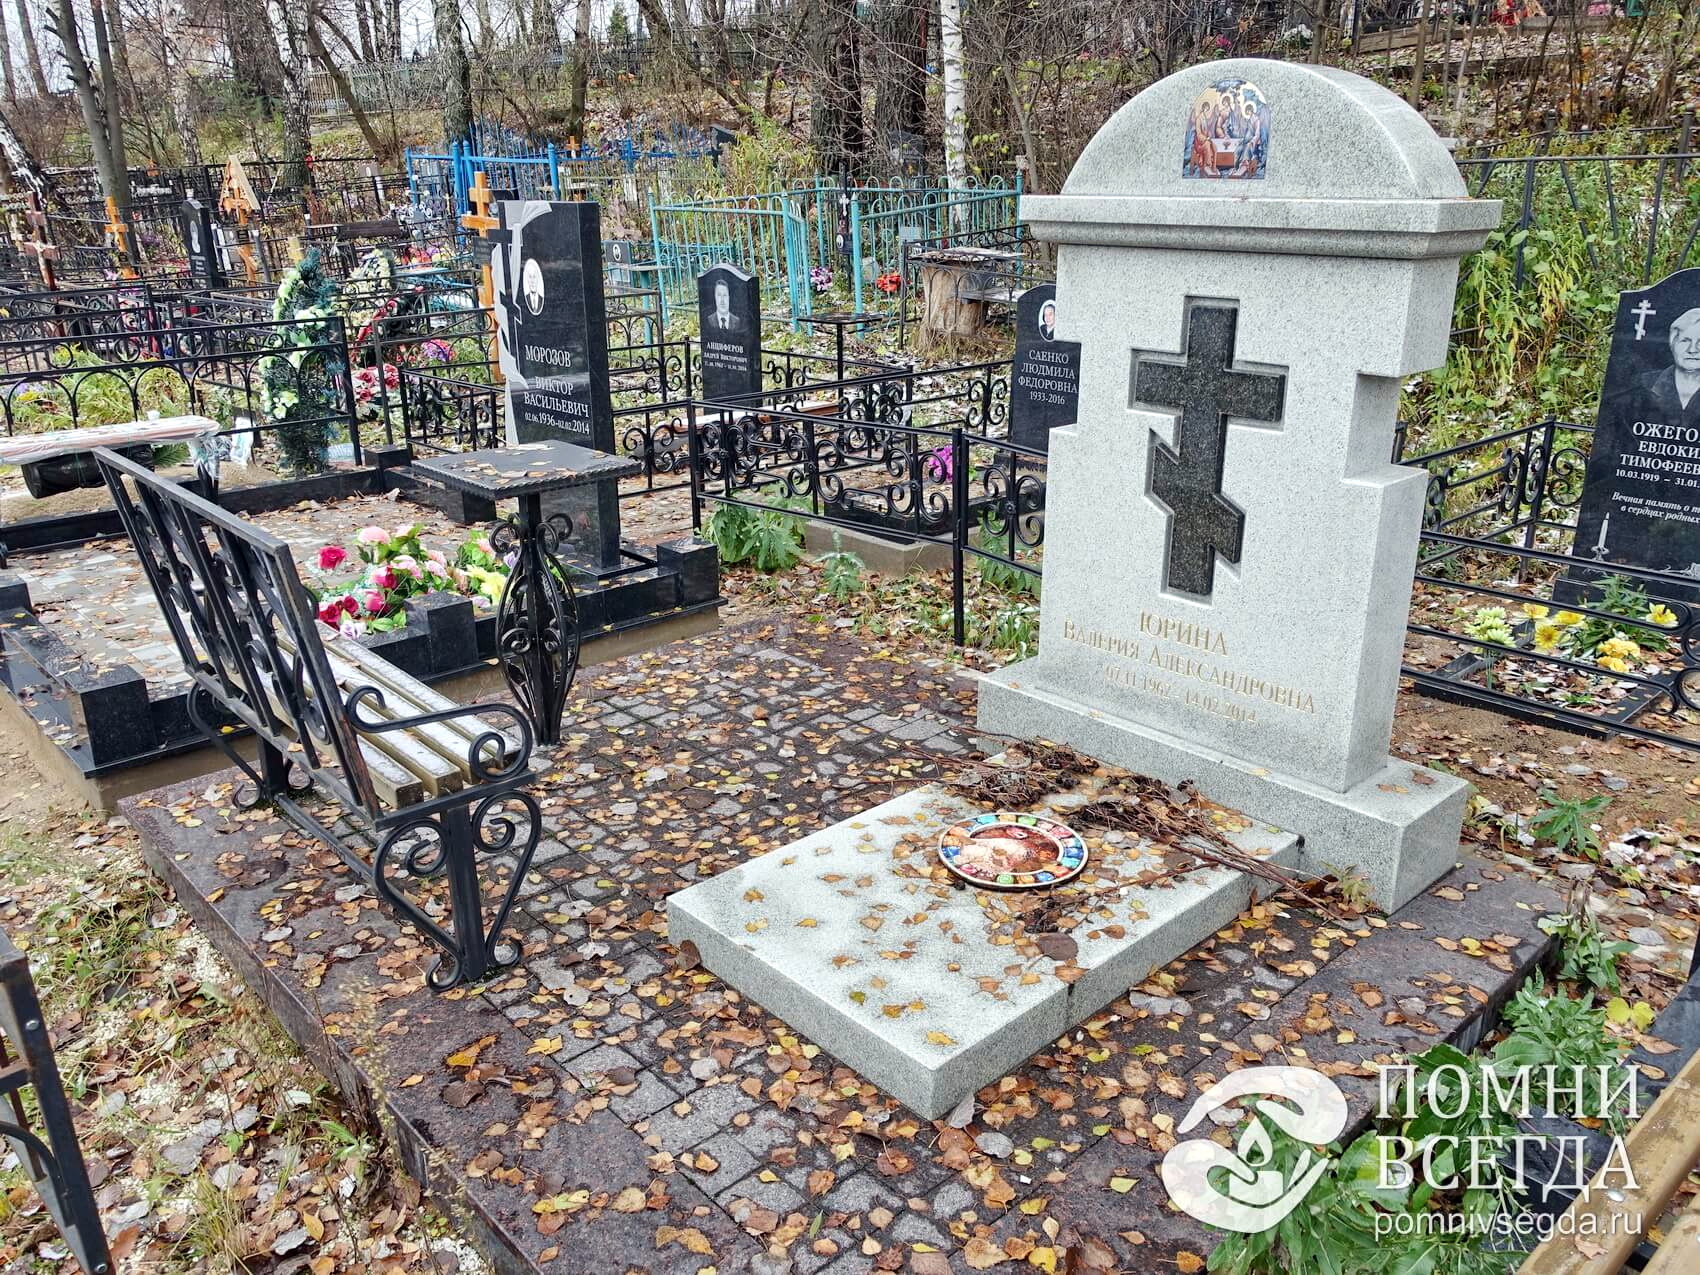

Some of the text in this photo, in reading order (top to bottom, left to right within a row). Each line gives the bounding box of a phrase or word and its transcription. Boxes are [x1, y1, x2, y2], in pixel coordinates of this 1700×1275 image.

[525, 345, 571, 368] МОРОЗОВ
[1029, 349, 1069, 364] САЕНКО
[1021, 362, 1075, 380] ЛЮДМИЛА
[535, 376, 574, 396] ВИКТОР
[1018, 375, 1079, 394] ФЕДОРОВНА
[523, 391, 590, 418] ВАСИЛЬЕВИЧ
[1030, 390, 1066, 405] 1933-2016
[1632, 421, 1700, 443] ОЖЕГО
[1638, 440, 1700, 460] ЕВДОКИ
[1620, 453, 1700, 476] ТИМОФЕЕВ
[1615, 468, 1660, 482] 10.03.1919
[1612, 491, 1643, 505] Вечная
[1645, 499, 1682, 512] память
[1683, 504, 1690, 512] о
[1627, 506, 1665, 519] сердцах
[1665, 511, 1700, 525] родных
[1140, 610, 1228, 656] ЮРИНА
[1063, 619, 1316, 715] ВАЛЕРИЯ АЛЕКСАНДРОВНА
